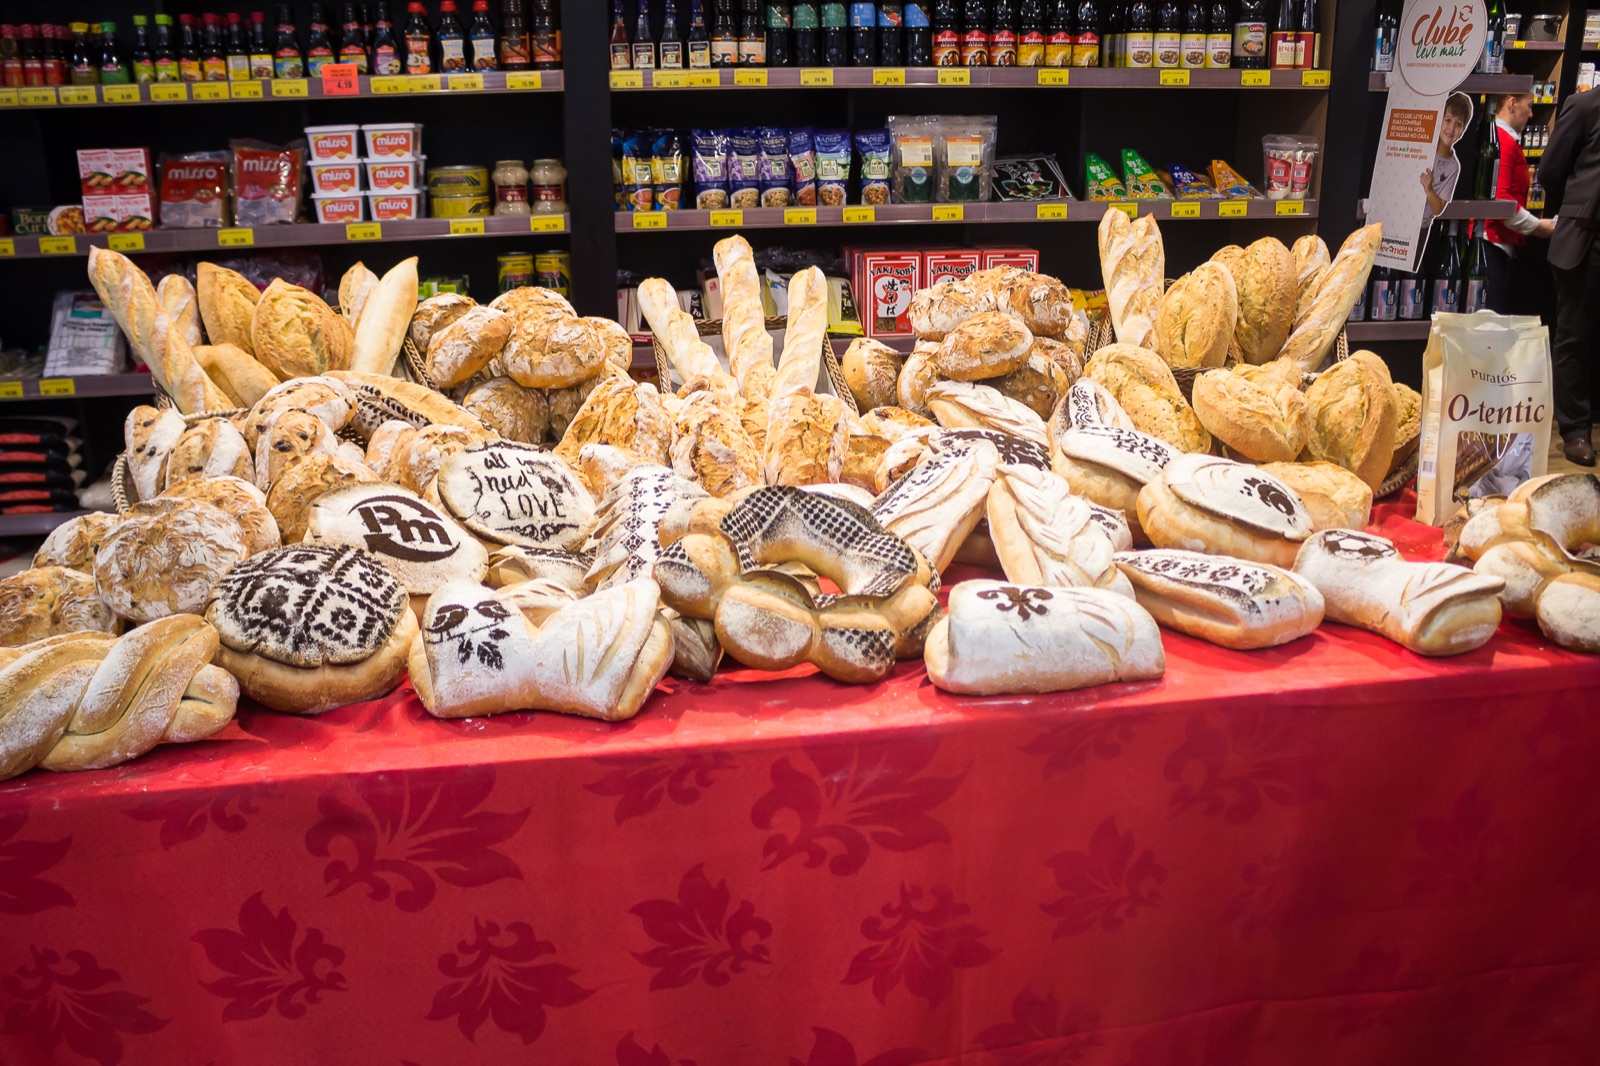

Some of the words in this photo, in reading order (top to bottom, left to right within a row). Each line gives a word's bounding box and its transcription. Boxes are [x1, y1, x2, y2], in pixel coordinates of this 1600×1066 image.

[1412, 6, 1473, 46] Clube
[1440, 44, 1467, 57] mais
[869, 266, 894, 277] YAKI
[895, 265, 916, 276] SOBA
[930, 265, 953, 275] YAKI
[955, 263, 976, 274] SOBA
[1470, 368, 1517, 383] Puratos
[1448, 394, 1545, 425] O-tentic
[1461, 432, 1510, 444] ORIGN
[484, 452, 510, 469] all
[500, 493, 566, 520] LOVE
